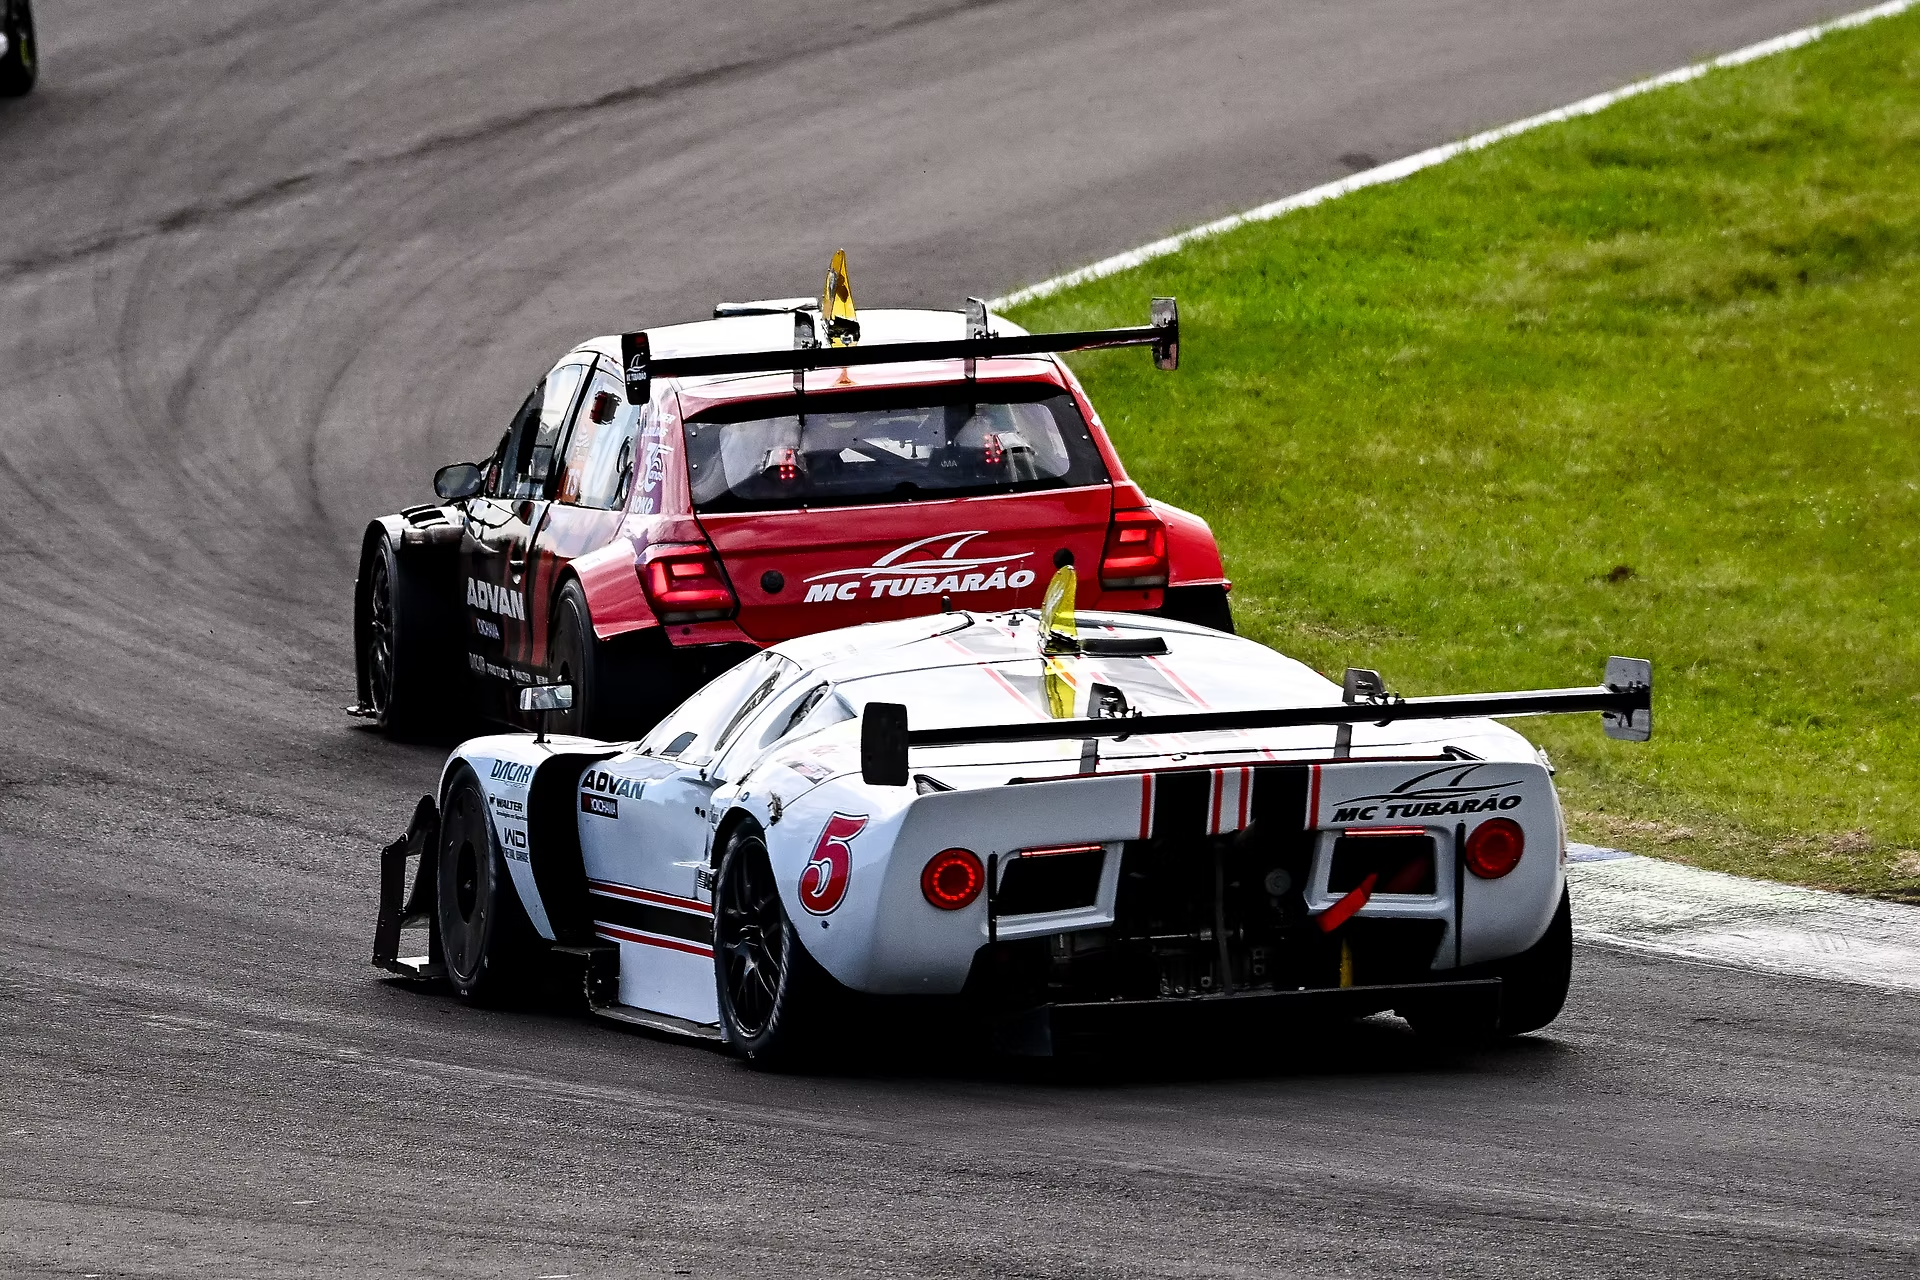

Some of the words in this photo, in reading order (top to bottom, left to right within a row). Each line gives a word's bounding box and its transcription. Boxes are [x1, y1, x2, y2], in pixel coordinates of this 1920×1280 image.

[466, 576, 525, 621] ADVAN
[803, 582, 860, 603] MC
[869, 566, 1036, 598] TUBARÃO
[490, 758, 533, 784] DACAR
[581, 769, 647, 800] ADVAN
[496, 797, 523, 813] WALTER
[1331, 805, 1379, 822] MC
[1386, 793, 1522, 819] TUBARÃO
[504, 827, 527, 849] WD
[798, 810, 870, 917] 5
